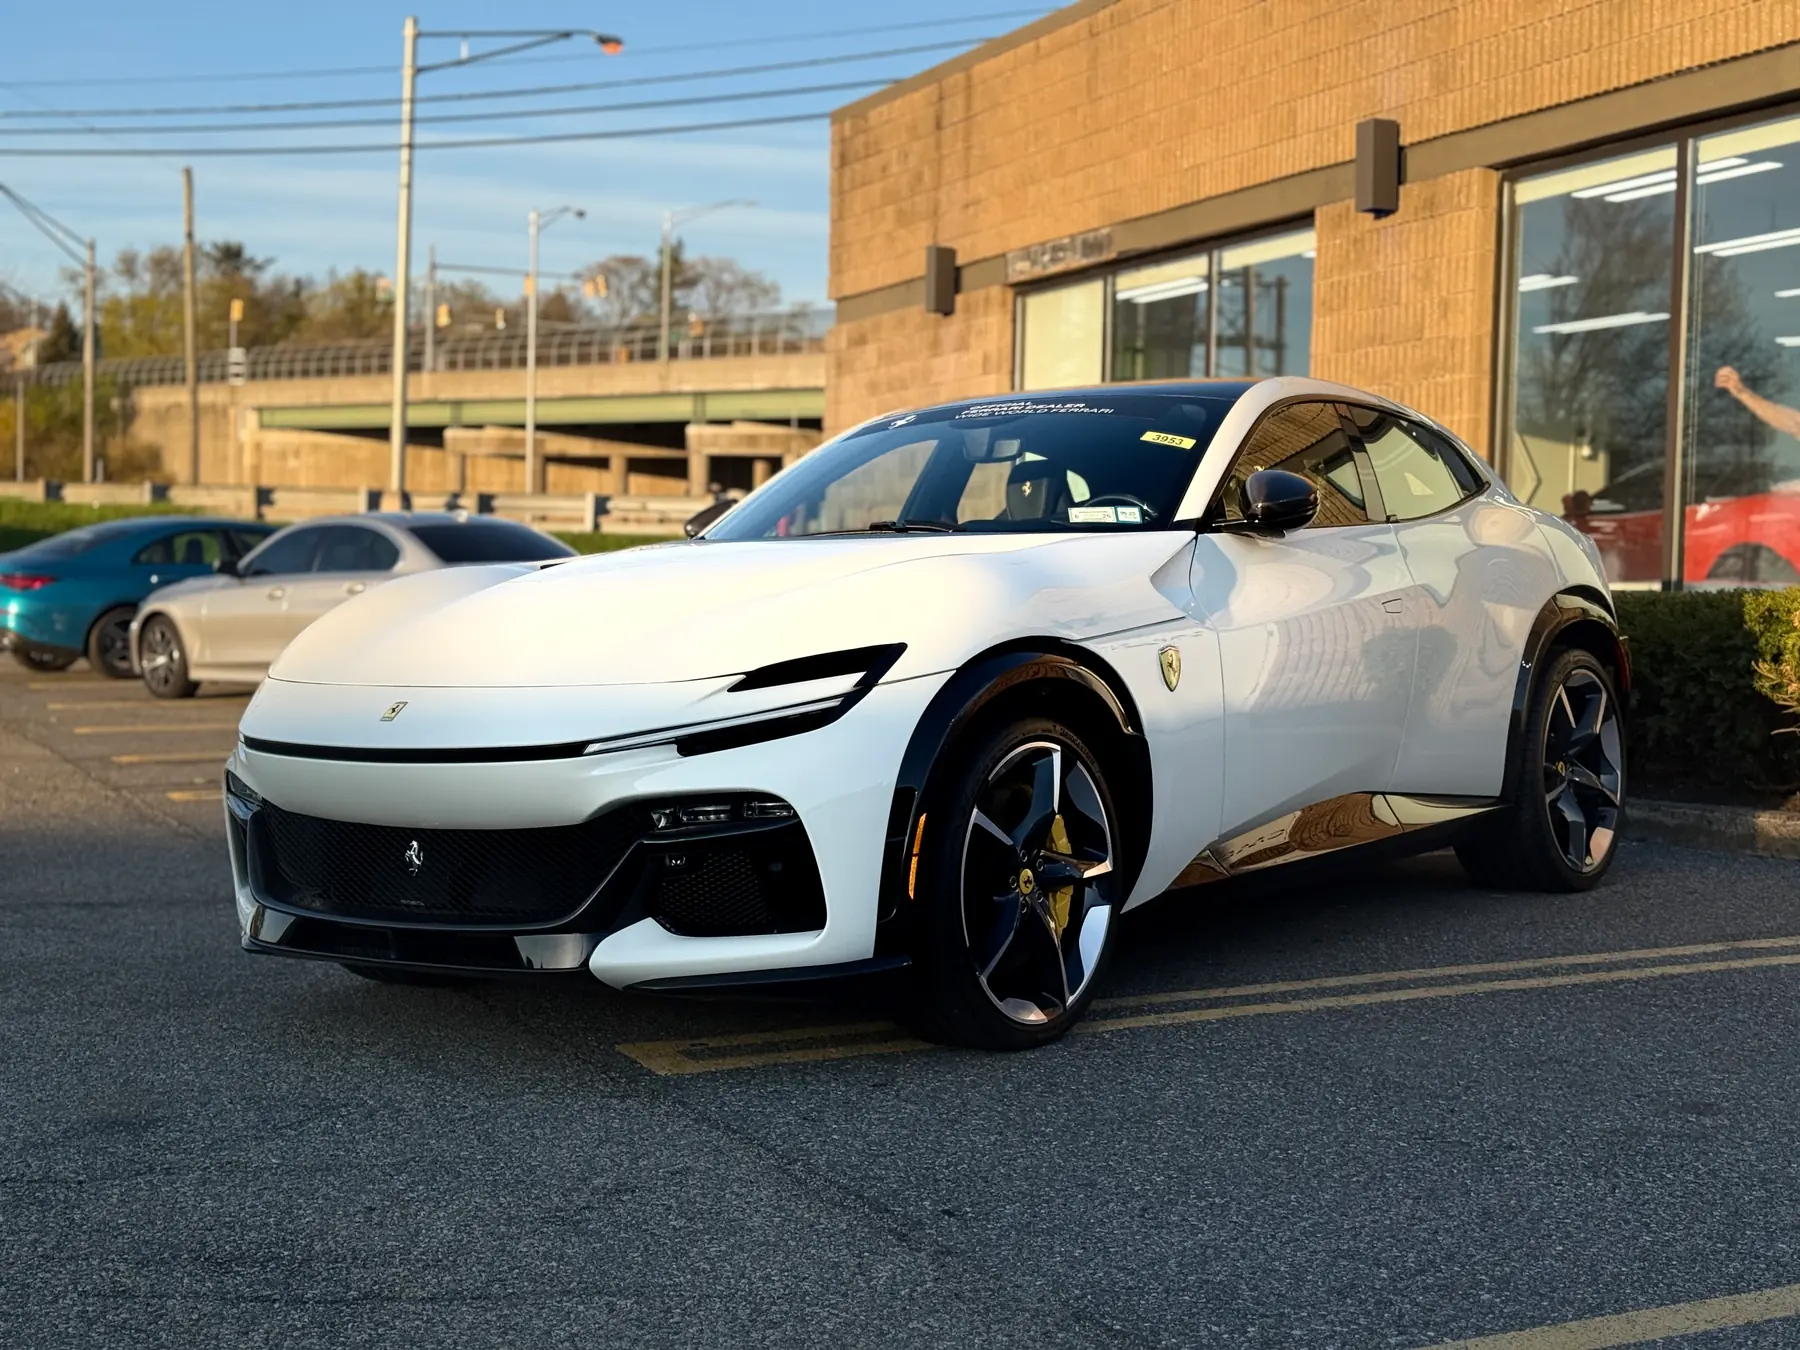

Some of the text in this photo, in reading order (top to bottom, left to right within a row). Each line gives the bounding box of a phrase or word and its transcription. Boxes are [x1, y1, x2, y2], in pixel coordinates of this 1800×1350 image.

[961, 405, 1024, 415] FERRARI
[969, 401, 1031, 410] OFFICIAL
[994, 408, 1047, 416] WORLD
[1152, 434, 1184, 446] 3953
